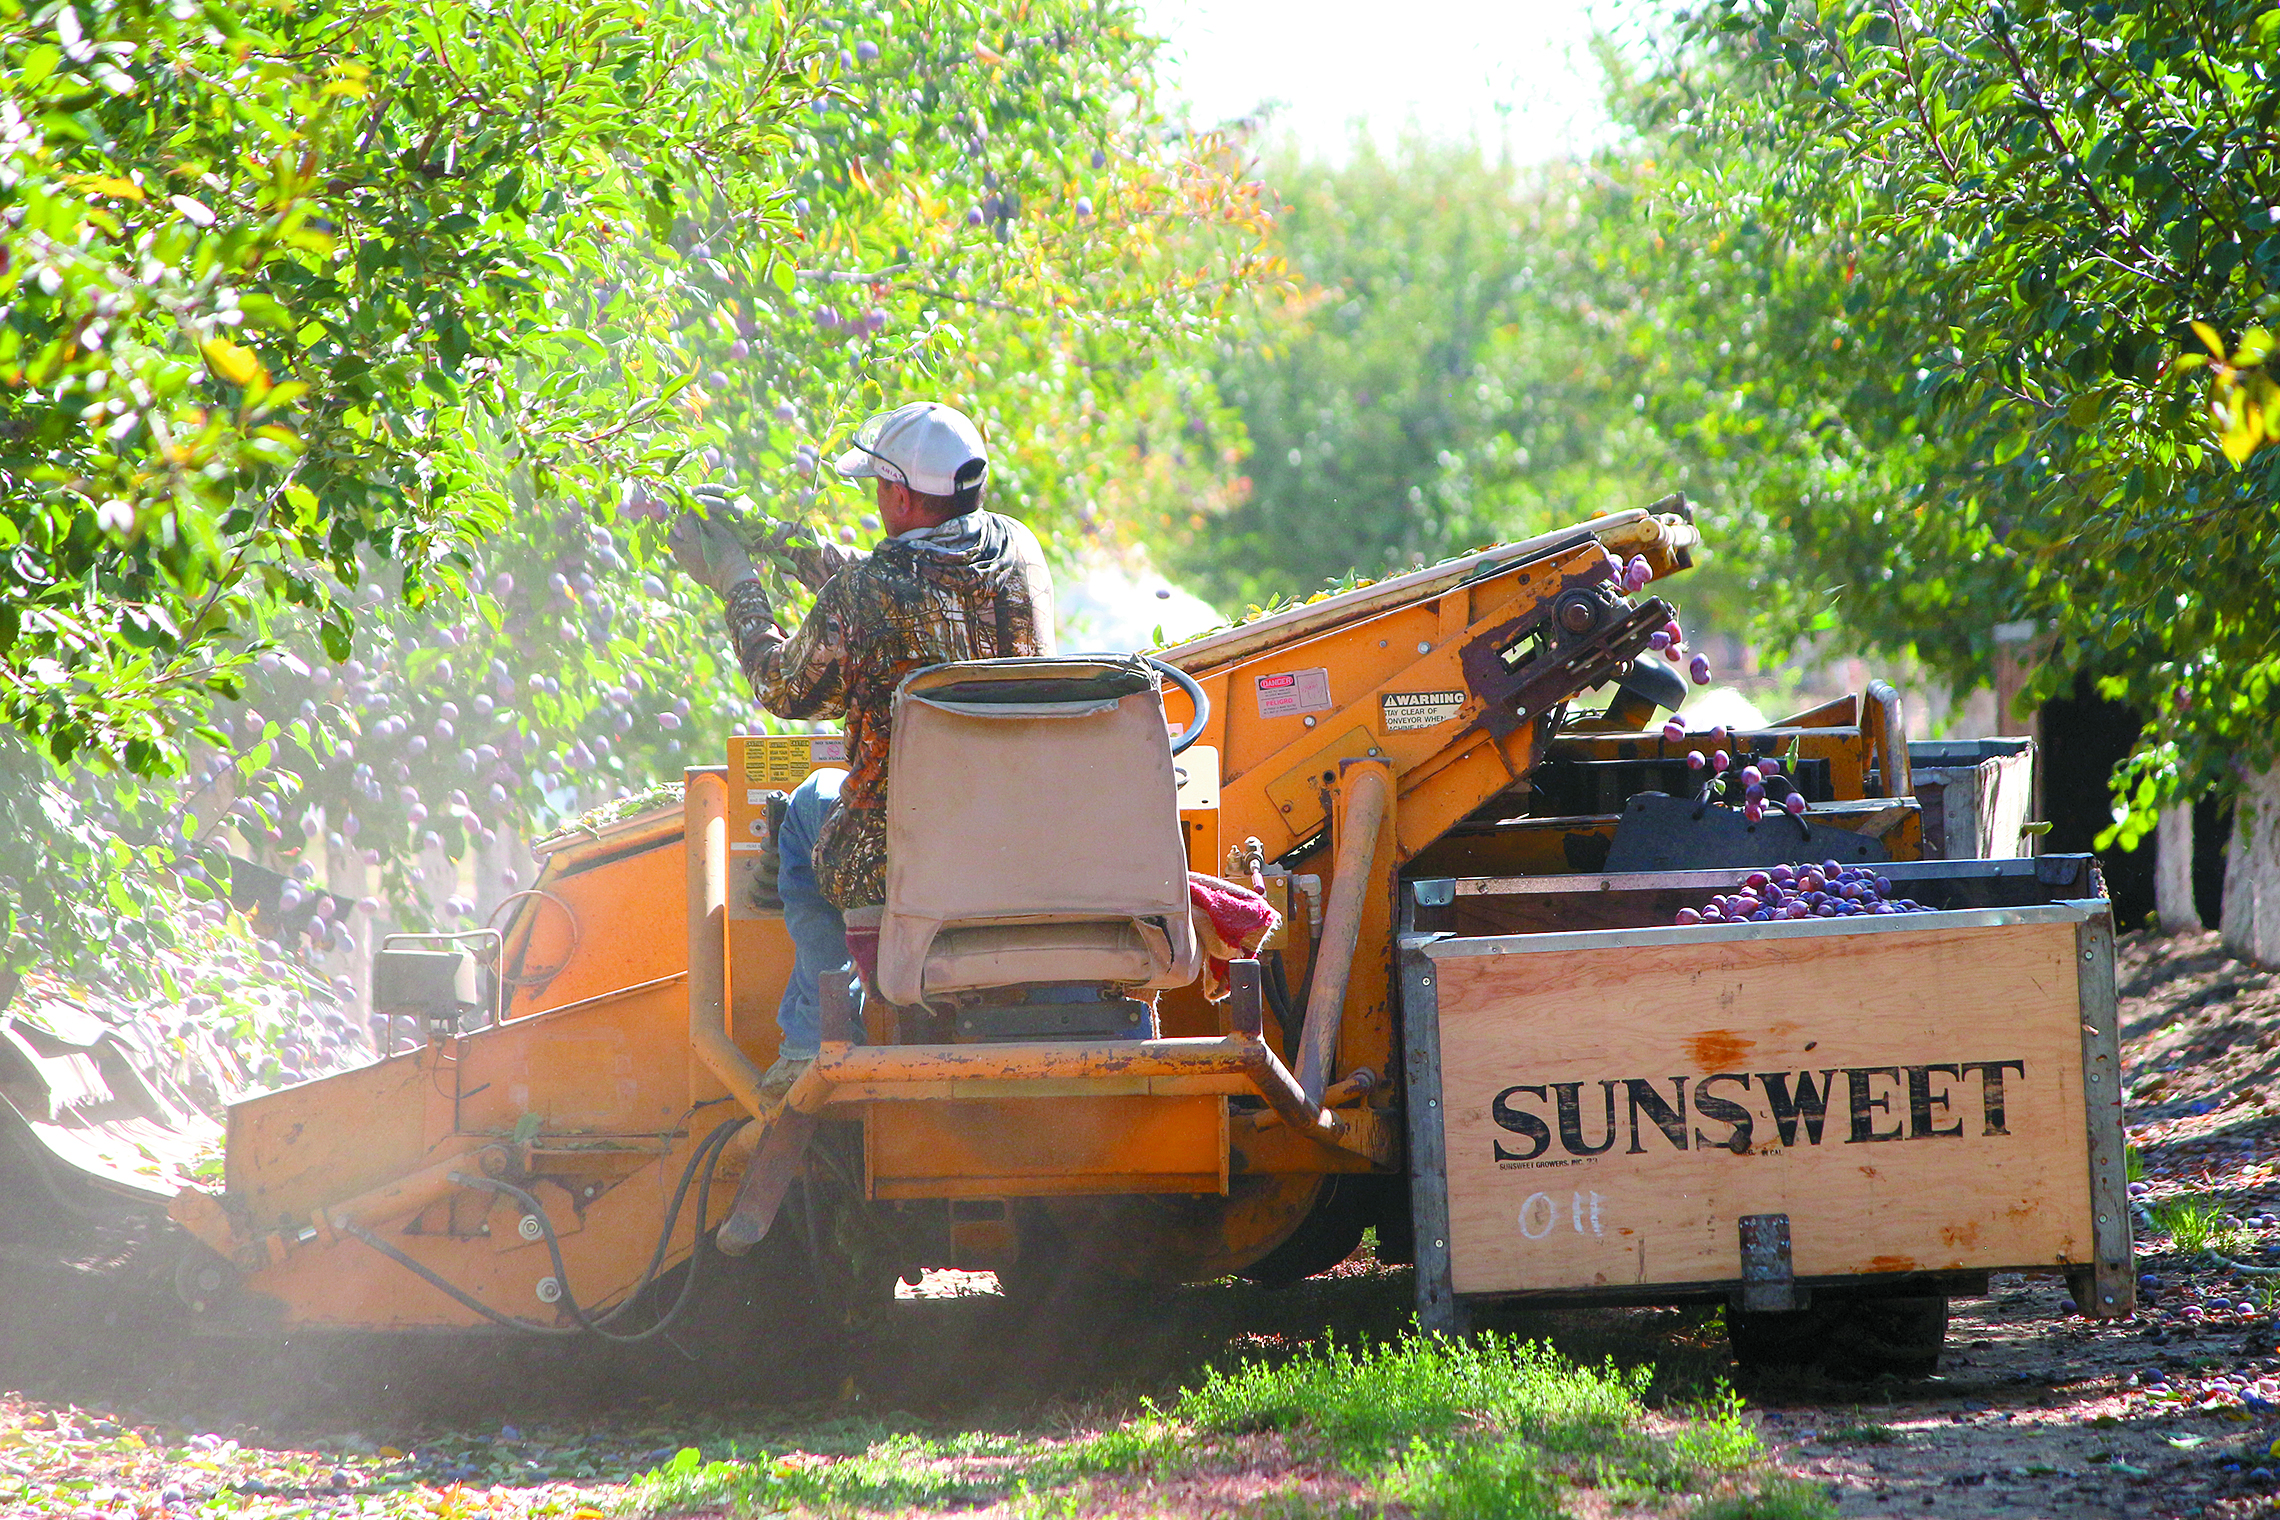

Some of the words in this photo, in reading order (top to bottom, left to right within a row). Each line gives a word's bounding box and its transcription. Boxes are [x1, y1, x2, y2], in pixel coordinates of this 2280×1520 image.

[881, 465, 904, 479] ARIAT
[1263, 677, 1292, 687] DANGER
[1266, 698, 1293, 706] PELIGRO
[1396, 692, 1465, 706] WARNING
[1401, 708, 1425, 716] CLEAR
[1428, 707, 1438, 715] OF
[1386, 717, 1422, 725] ONVEYOR
[1492, 1059, 2025, 1163] SUNSWEET
[1500, 1161, 1534, 1170] SUNSWEET
